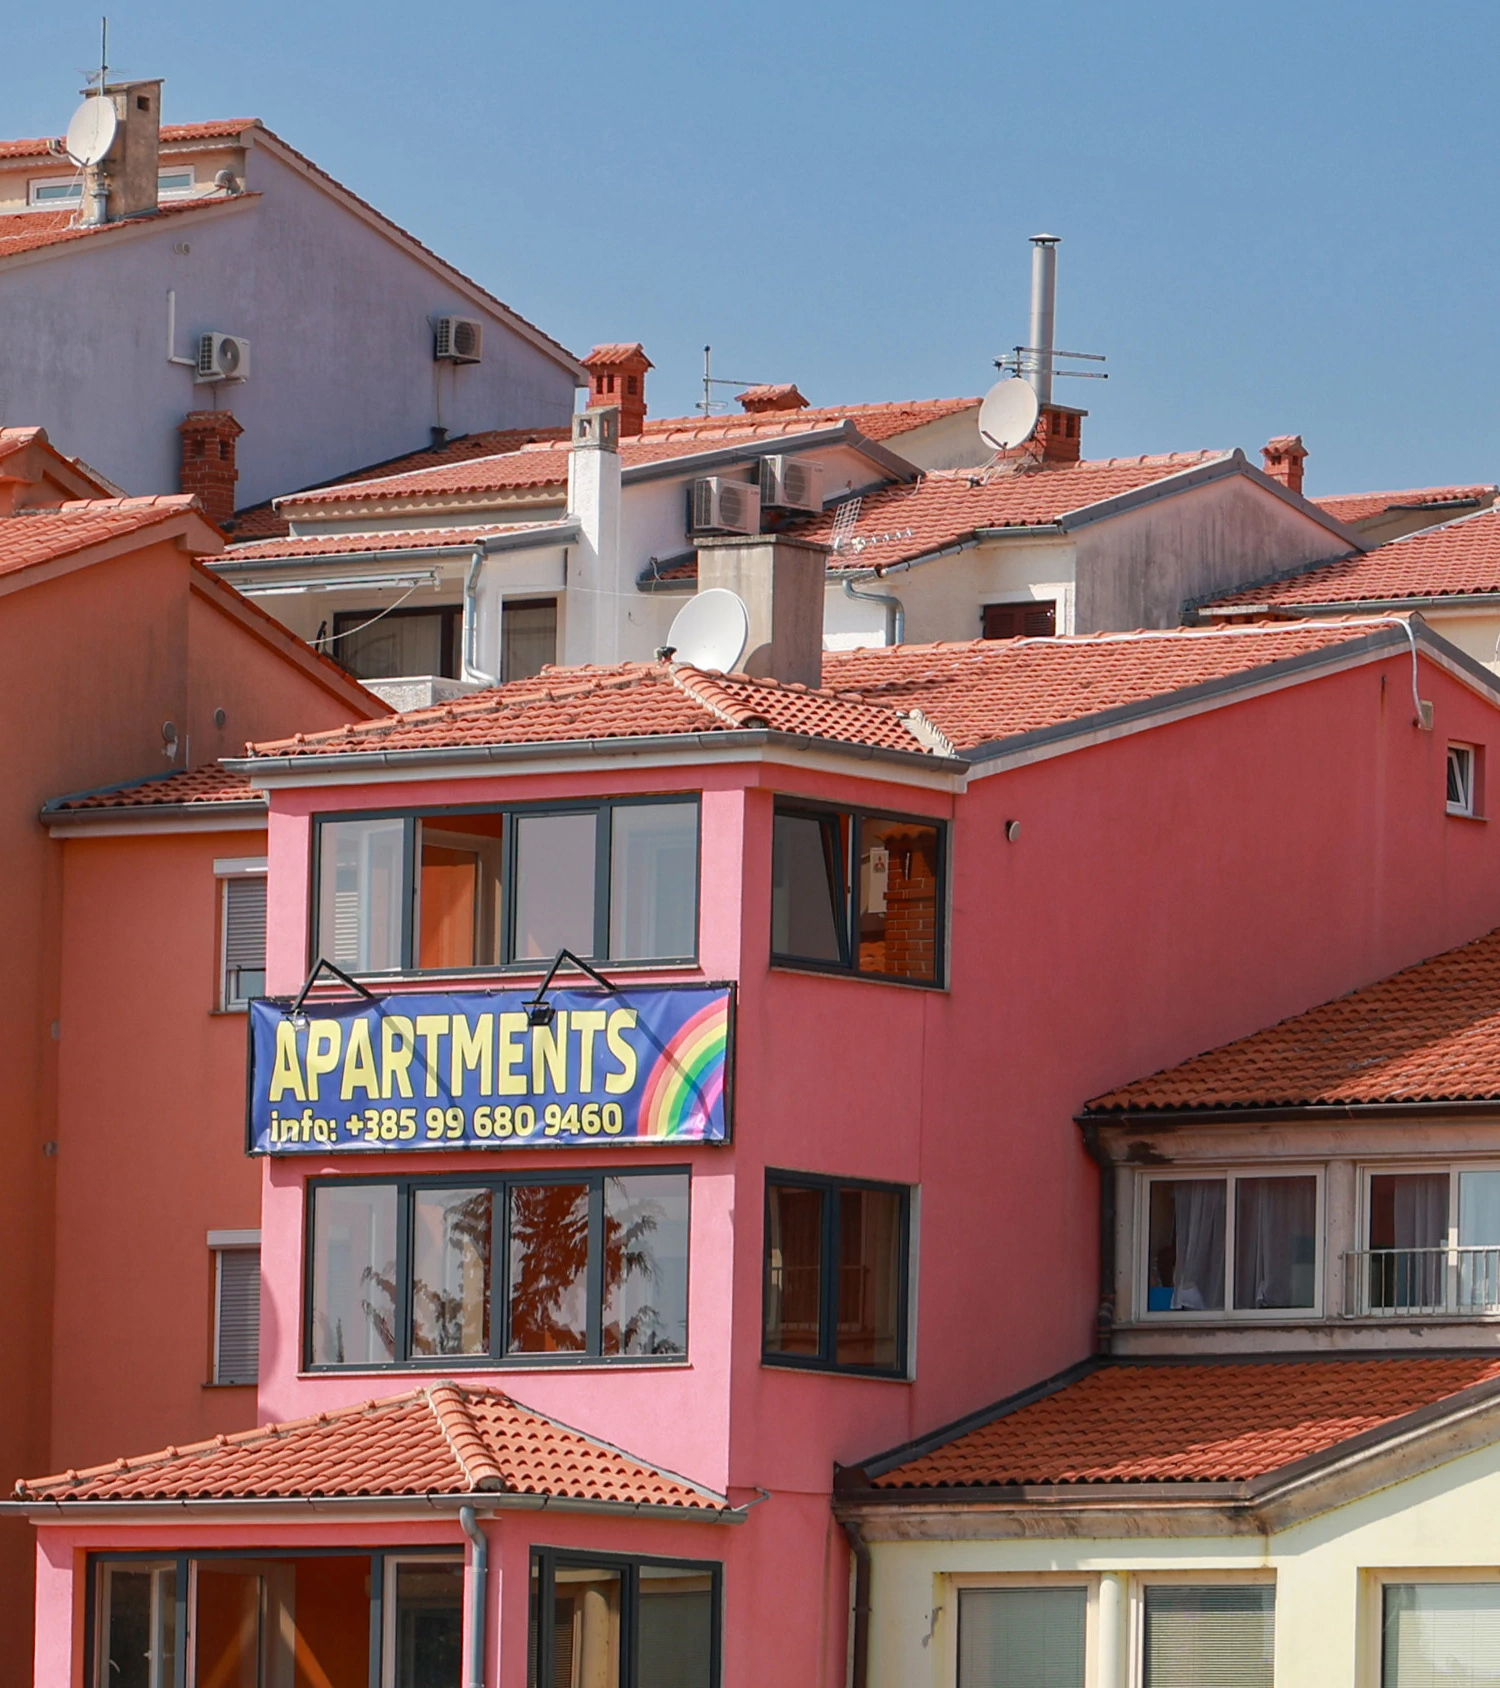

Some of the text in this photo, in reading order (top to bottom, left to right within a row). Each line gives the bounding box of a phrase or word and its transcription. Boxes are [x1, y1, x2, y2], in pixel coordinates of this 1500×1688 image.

[269, 1008, 638, 1102] APARTMENTS
[270, 1102, 624, 1143] info: +385 99 680 9460
